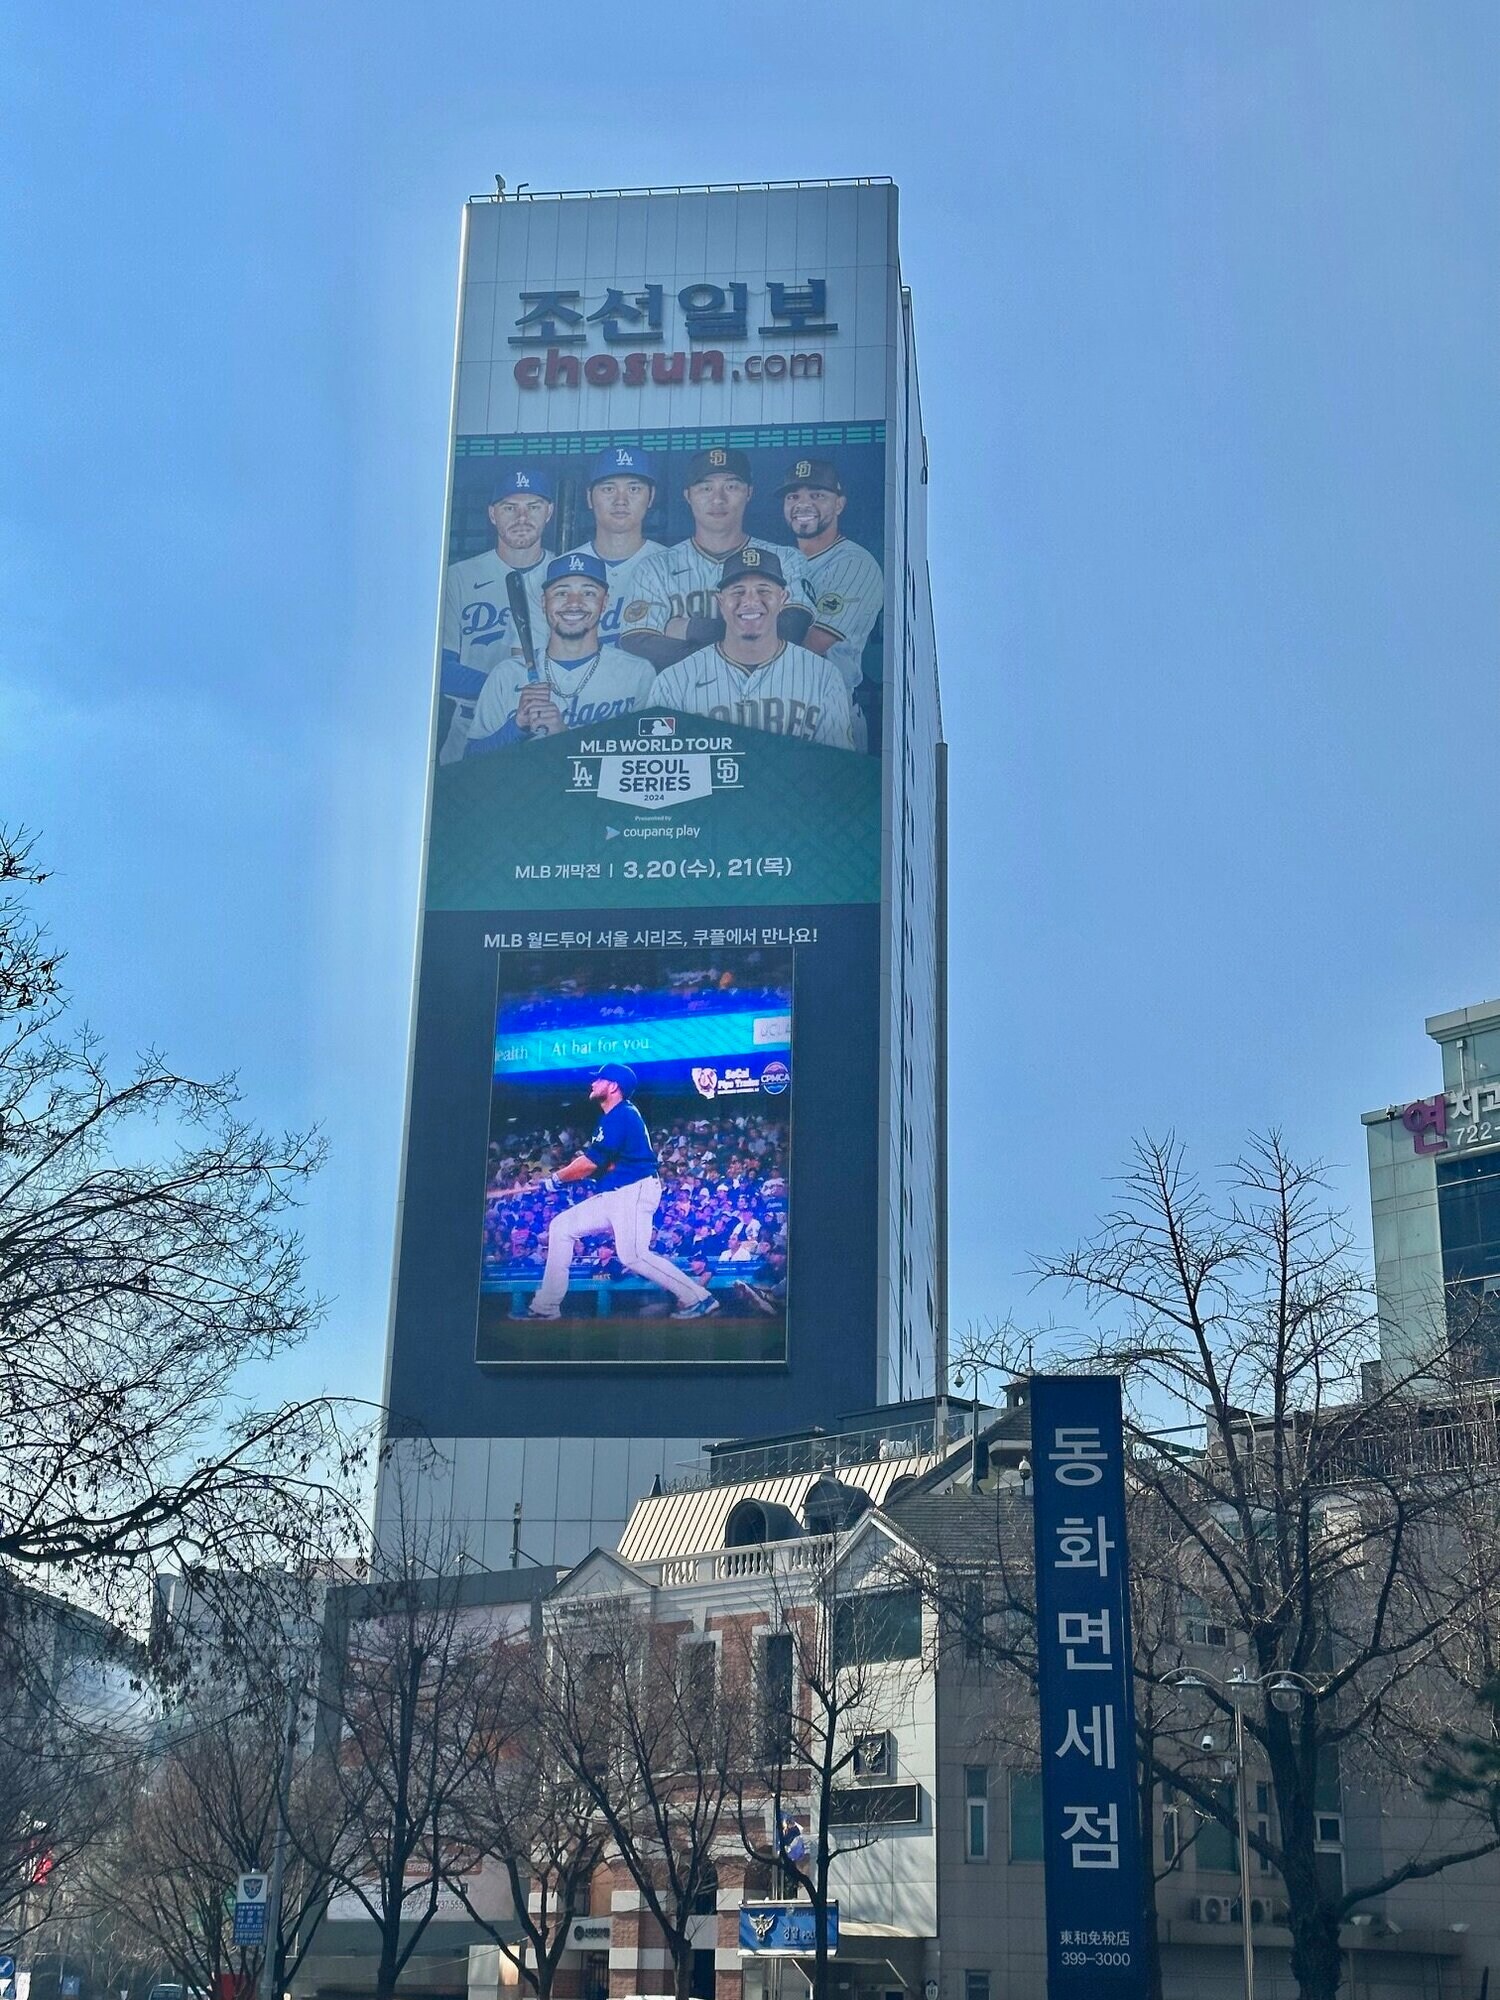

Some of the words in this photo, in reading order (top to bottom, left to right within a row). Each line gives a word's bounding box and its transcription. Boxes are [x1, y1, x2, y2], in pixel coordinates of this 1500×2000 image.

[507, 278, 839, 344] 조선일보
[513, 348, 823, 388] chosun.com
[616, 449, 633, 466] LA
[710, 449, 726, 466] SD
[796, 460, 811, 478] SD
[516, 471, 530, 488] LA
[568, 554, 585, 571] LA
[742, 549, 760, 567] SD
[580, 739, 617, 753] MLB
[620, 738, 683, 752] WORLD
[686, 737, 733, 751] TOUR
[572, 761, 593, 787] LA
[621, 759, 690, 776] SEOUL
[716, 758, 739, 784] SD
[619, 776, 691, 793] SERIES
[623, 827, 674, 840] coupang
[676, 824, 701, 839] play
[514, 865, 551, 879] MLB
[554, 863, 601, 880] 개막전
[728, 856, 793, 878] 21(목)
[483, 933, 523, 948] MLB
[526, 931, 593, 949] 월드투어
[596, 930, 630, 948] 서울
[633, 929, 688, 948] 시리즈,
[692, 927, 757, 946] 쿠플에서
[761, 926, 818, 945] 만나요!
[494, 1045, 529, 1062] ealth
[551, 1041, 567, 1057] At
[571, 1038, 592, 1055] bat
[598, 1036, 620, 1053] for
[1048, 1426, 1120, 1870] 동화면세점
[1061, 1951, 1131, 1966] 399-3000
